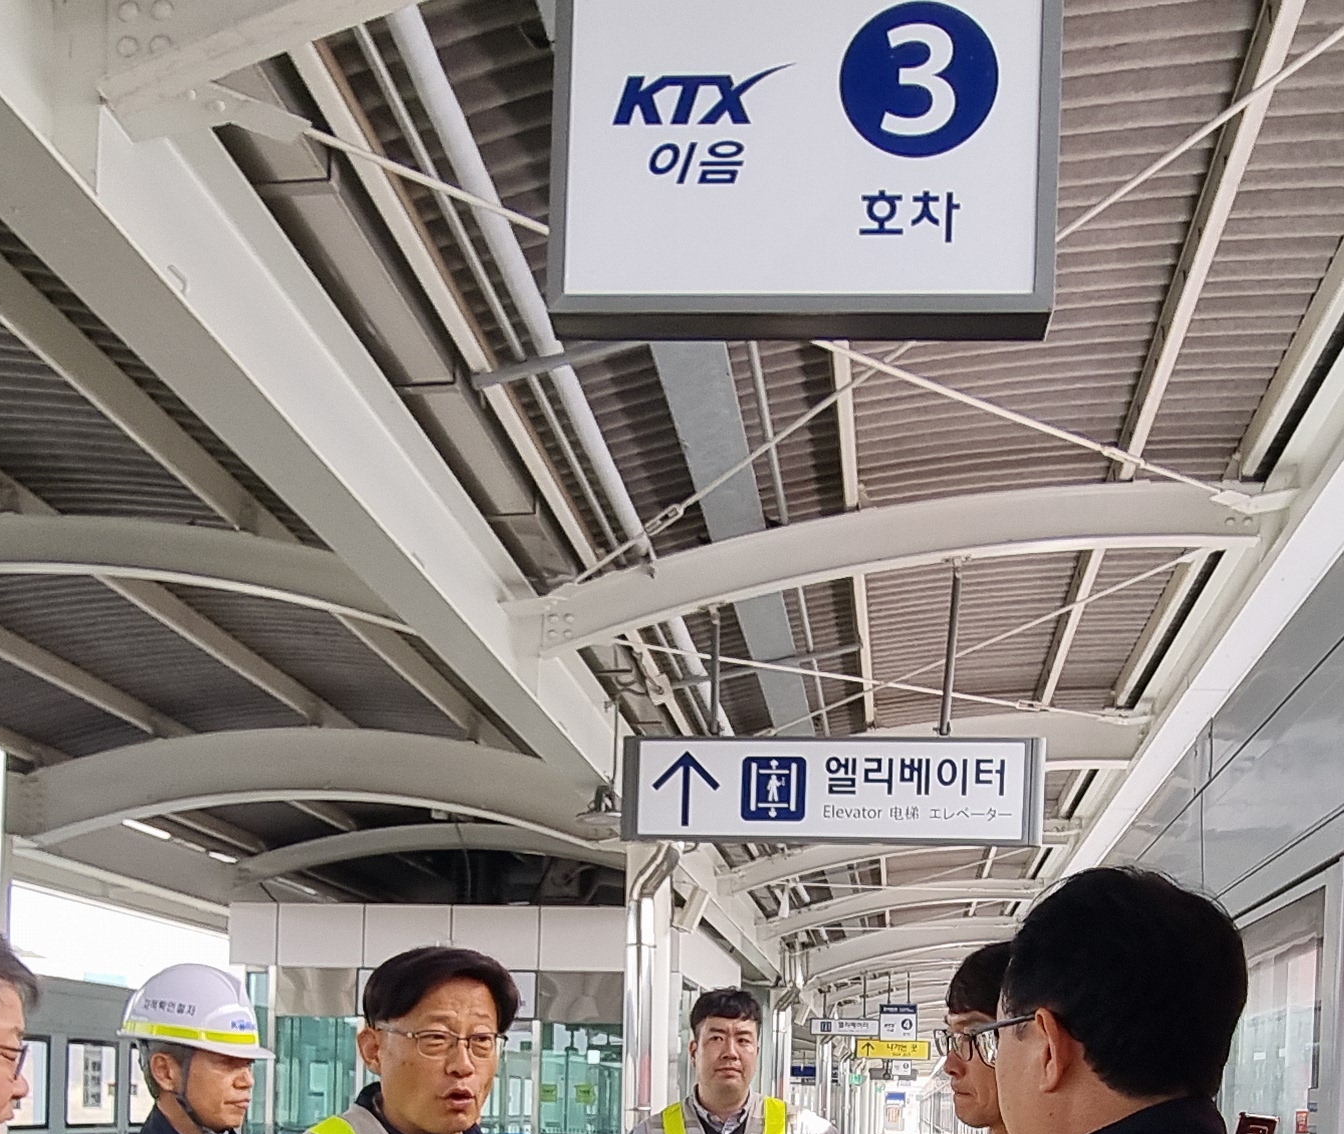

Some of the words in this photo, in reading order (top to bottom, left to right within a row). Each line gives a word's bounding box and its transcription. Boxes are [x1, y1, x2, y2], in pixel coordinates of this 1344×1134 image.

[613, 62, 797, 126] KTX
[879, 22, 955, 137] 3
[648, 140, 745, 184] 이음
[858, 189, 962, 243] 호차
[824, 756, 1007, 797] 엘리베이터
[822, 804, 883, 821] Elevator
[889, 805, 920, 822] 电梯
[928, 807, 1013, 821] エレベーター
